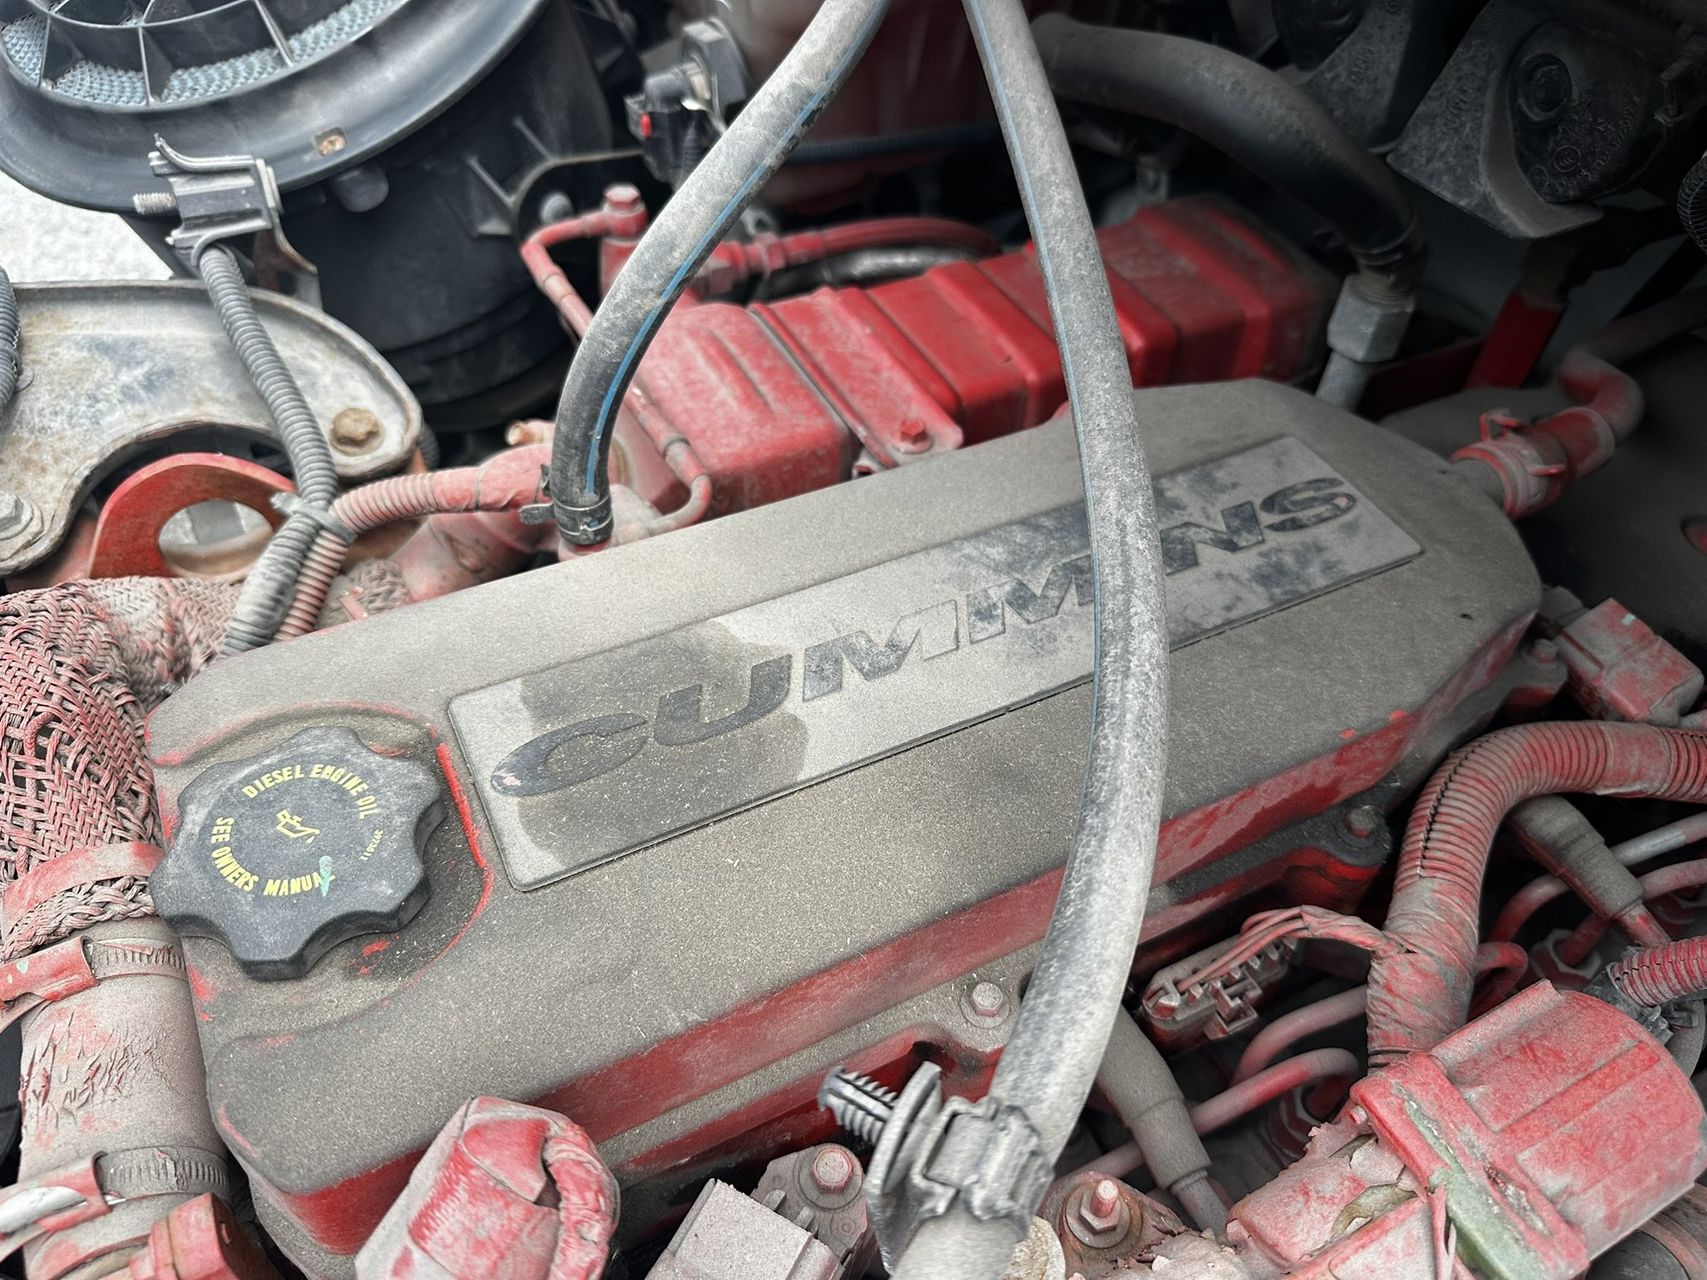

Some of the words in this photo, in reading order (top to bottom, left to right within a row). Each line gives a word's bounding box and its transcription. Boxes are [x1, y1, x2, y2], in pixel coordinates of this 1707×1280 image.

[491, 477, 1356, 797] CUMMNS
[242, 765, 304, 798] DIESEL
[310, 764, 369, 796] ENGINE
[355, 795, 378, 820] OIL
[210, 816, 235, 844] SEE
[211, 846, 259, 892] OWNERS
